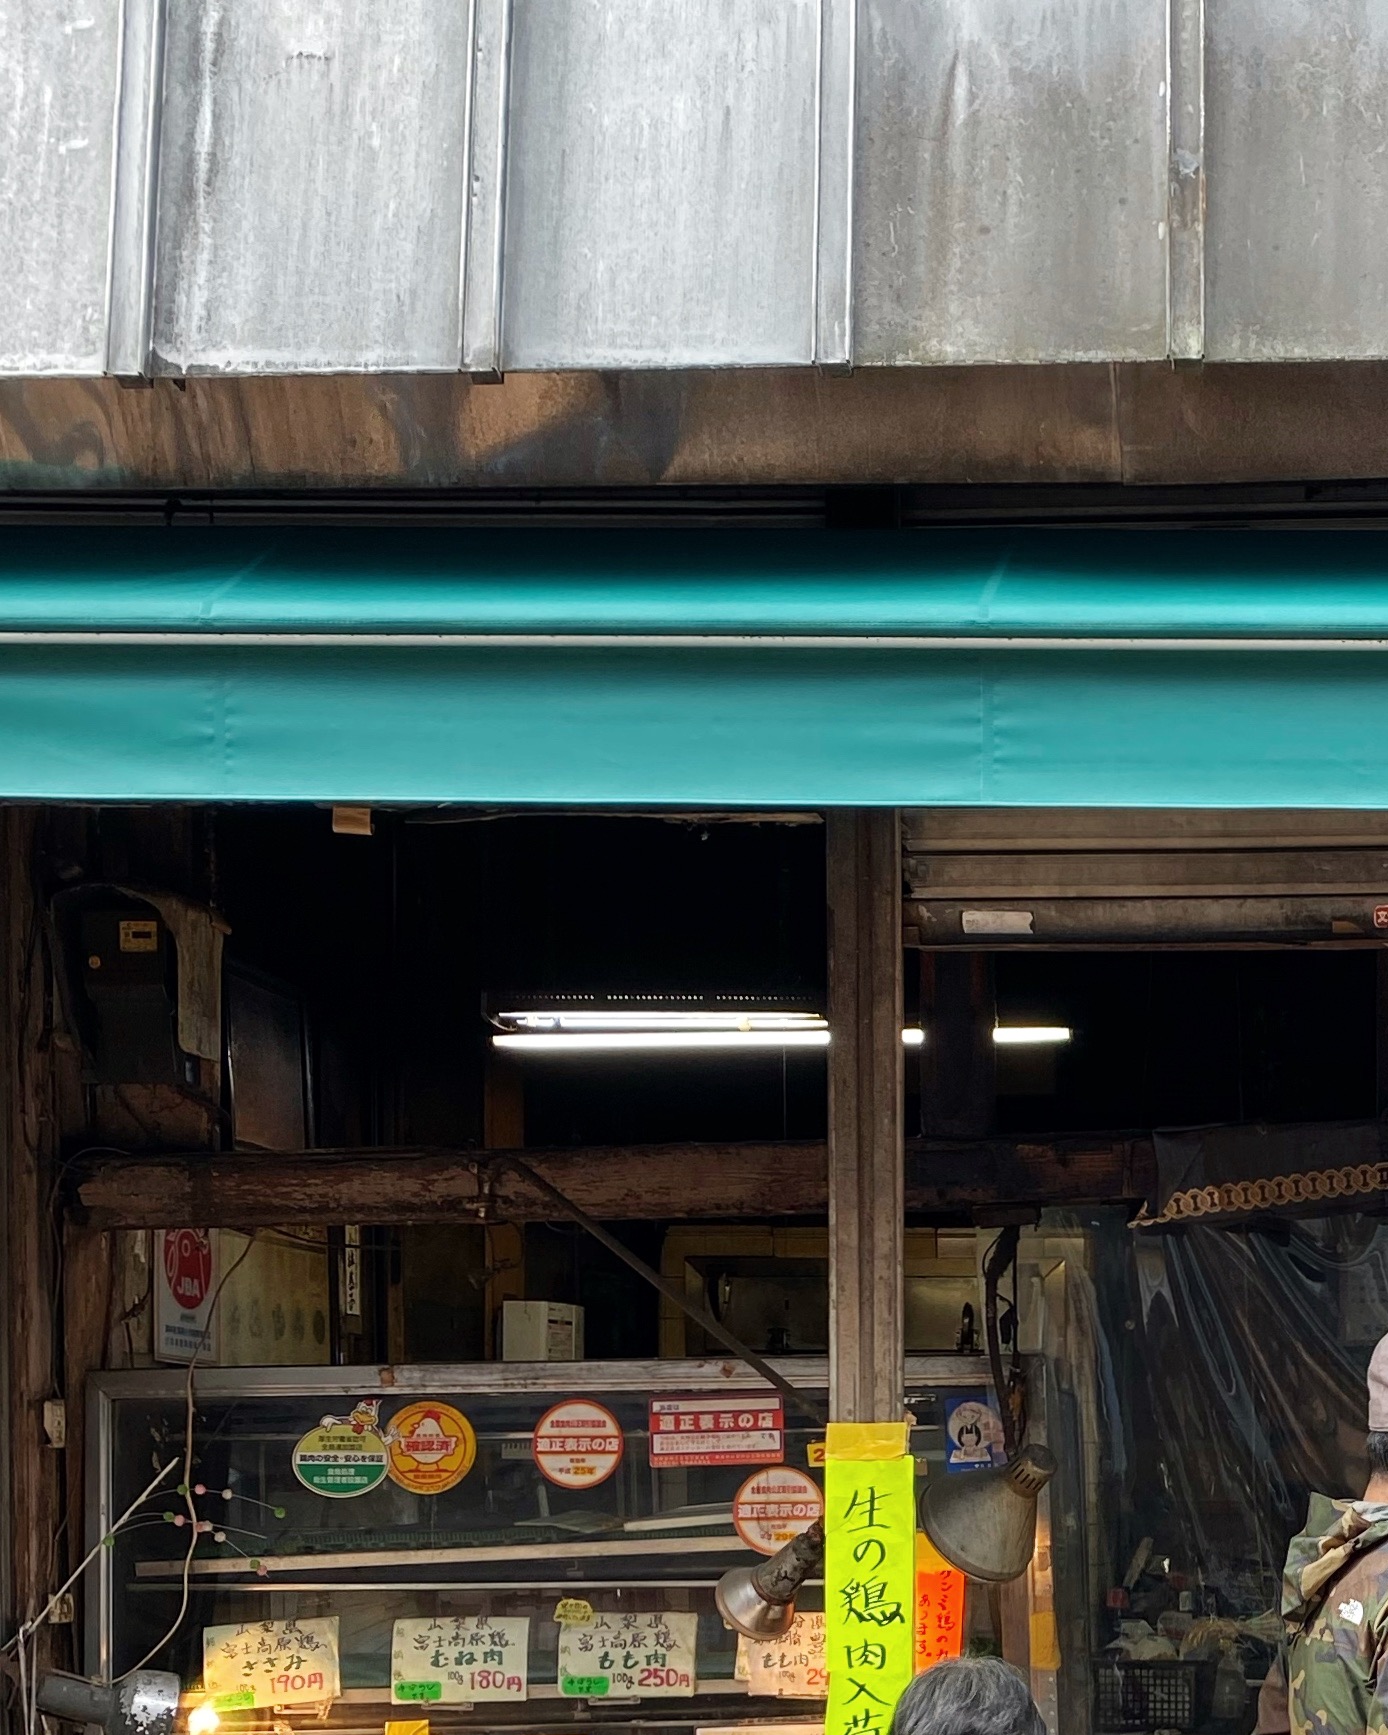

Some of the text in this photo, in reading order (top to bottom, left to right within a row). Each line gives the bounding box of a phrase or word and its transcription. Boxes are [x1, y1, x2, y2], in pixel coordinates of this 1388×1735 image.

[658, 1412, 774, 1430] 適正表示の店
[536, 1437, 619, 1452] 適正表示の店
[737, 1503, 820, 1518] 適正表示の店
[241, 1653, 308, 1677] ささみ
[429, 1648, 504, 1668] むね肉
[598, 1650, 667, 1670] もも肉
[269, 1671, 324, 1694] 190円
[469, 1669, 522, 1692] 180円
[637, 1668, 690, 1688] 250円
